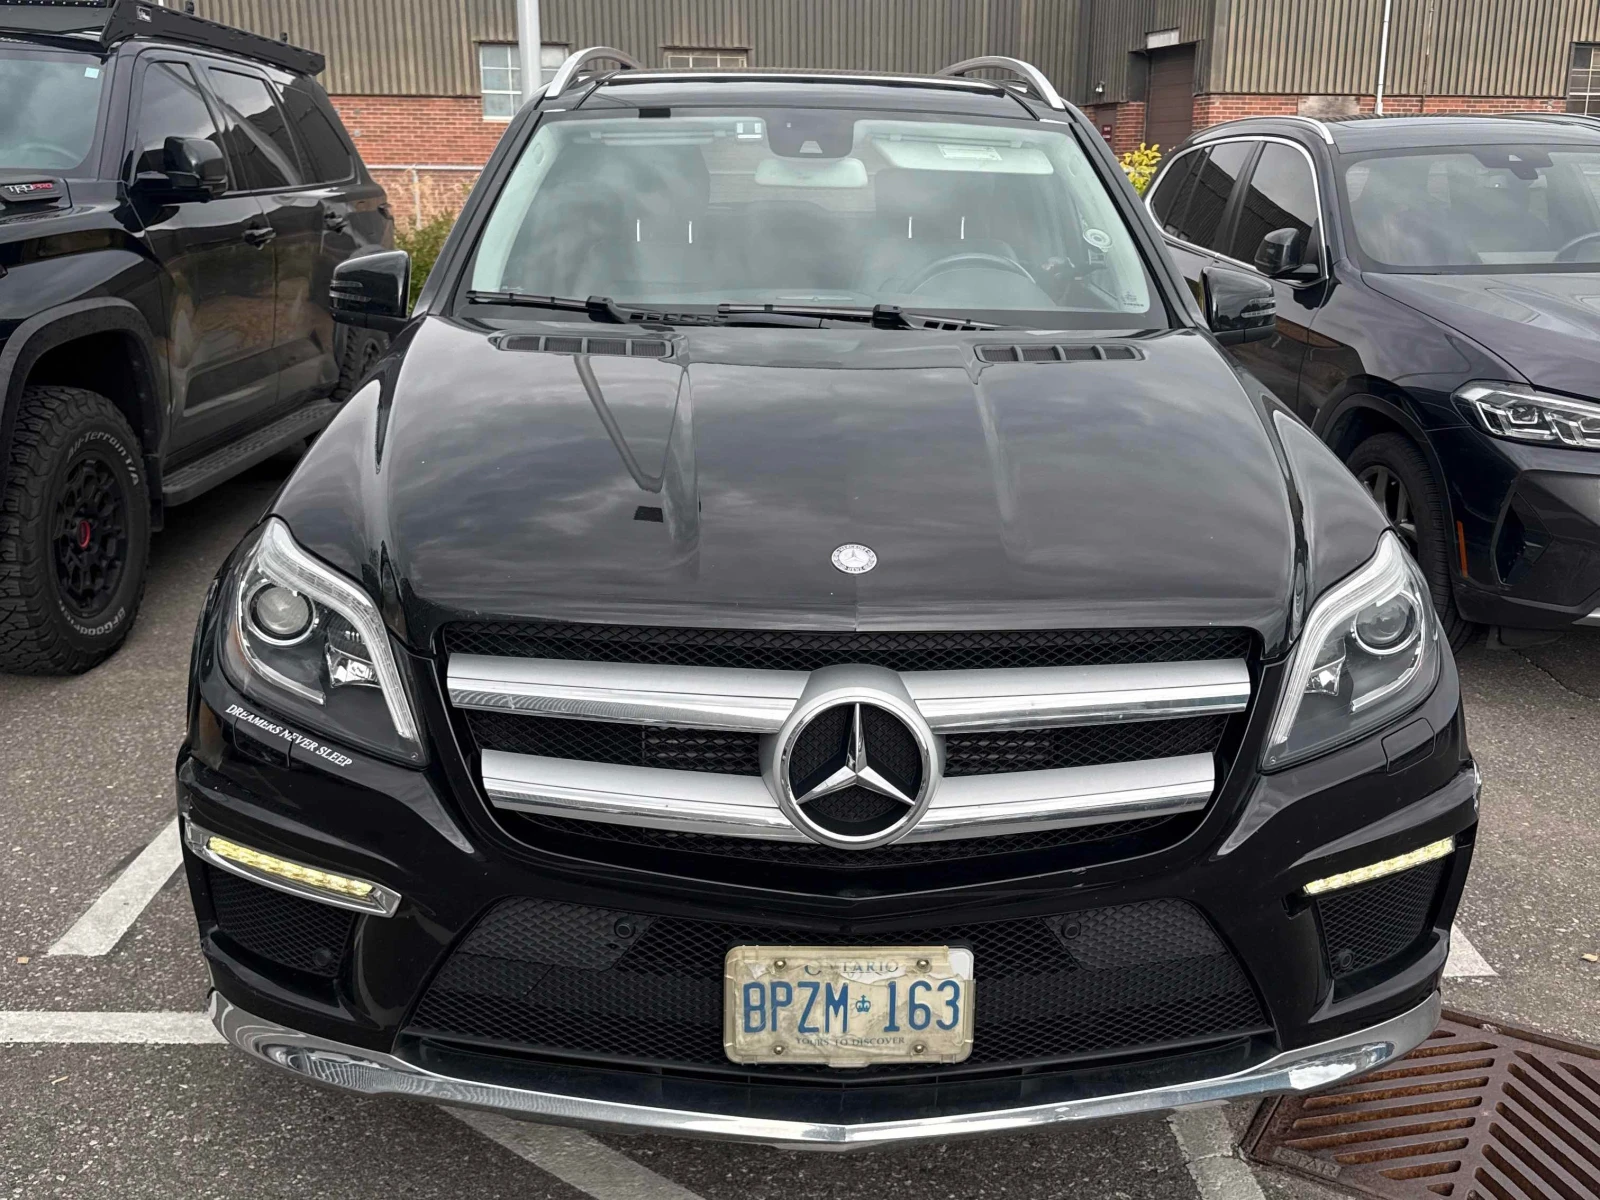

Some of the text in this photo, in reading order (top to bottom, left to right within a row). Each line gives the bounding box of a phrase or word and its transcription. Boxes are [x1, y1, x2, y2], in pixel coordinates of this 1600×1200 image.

[4, 184, 34, 194] TRD
[225, 703, 353, 767] DREAMERS NEVER SLEEP
[803, 961, 899, 977] OTARIO
[743, 979, 961, 1034] BPZM 163
[796, 1036, 905, 1047] YOURS TO DISCOVER
[1277, 1148, 1338, 1176] STAR
